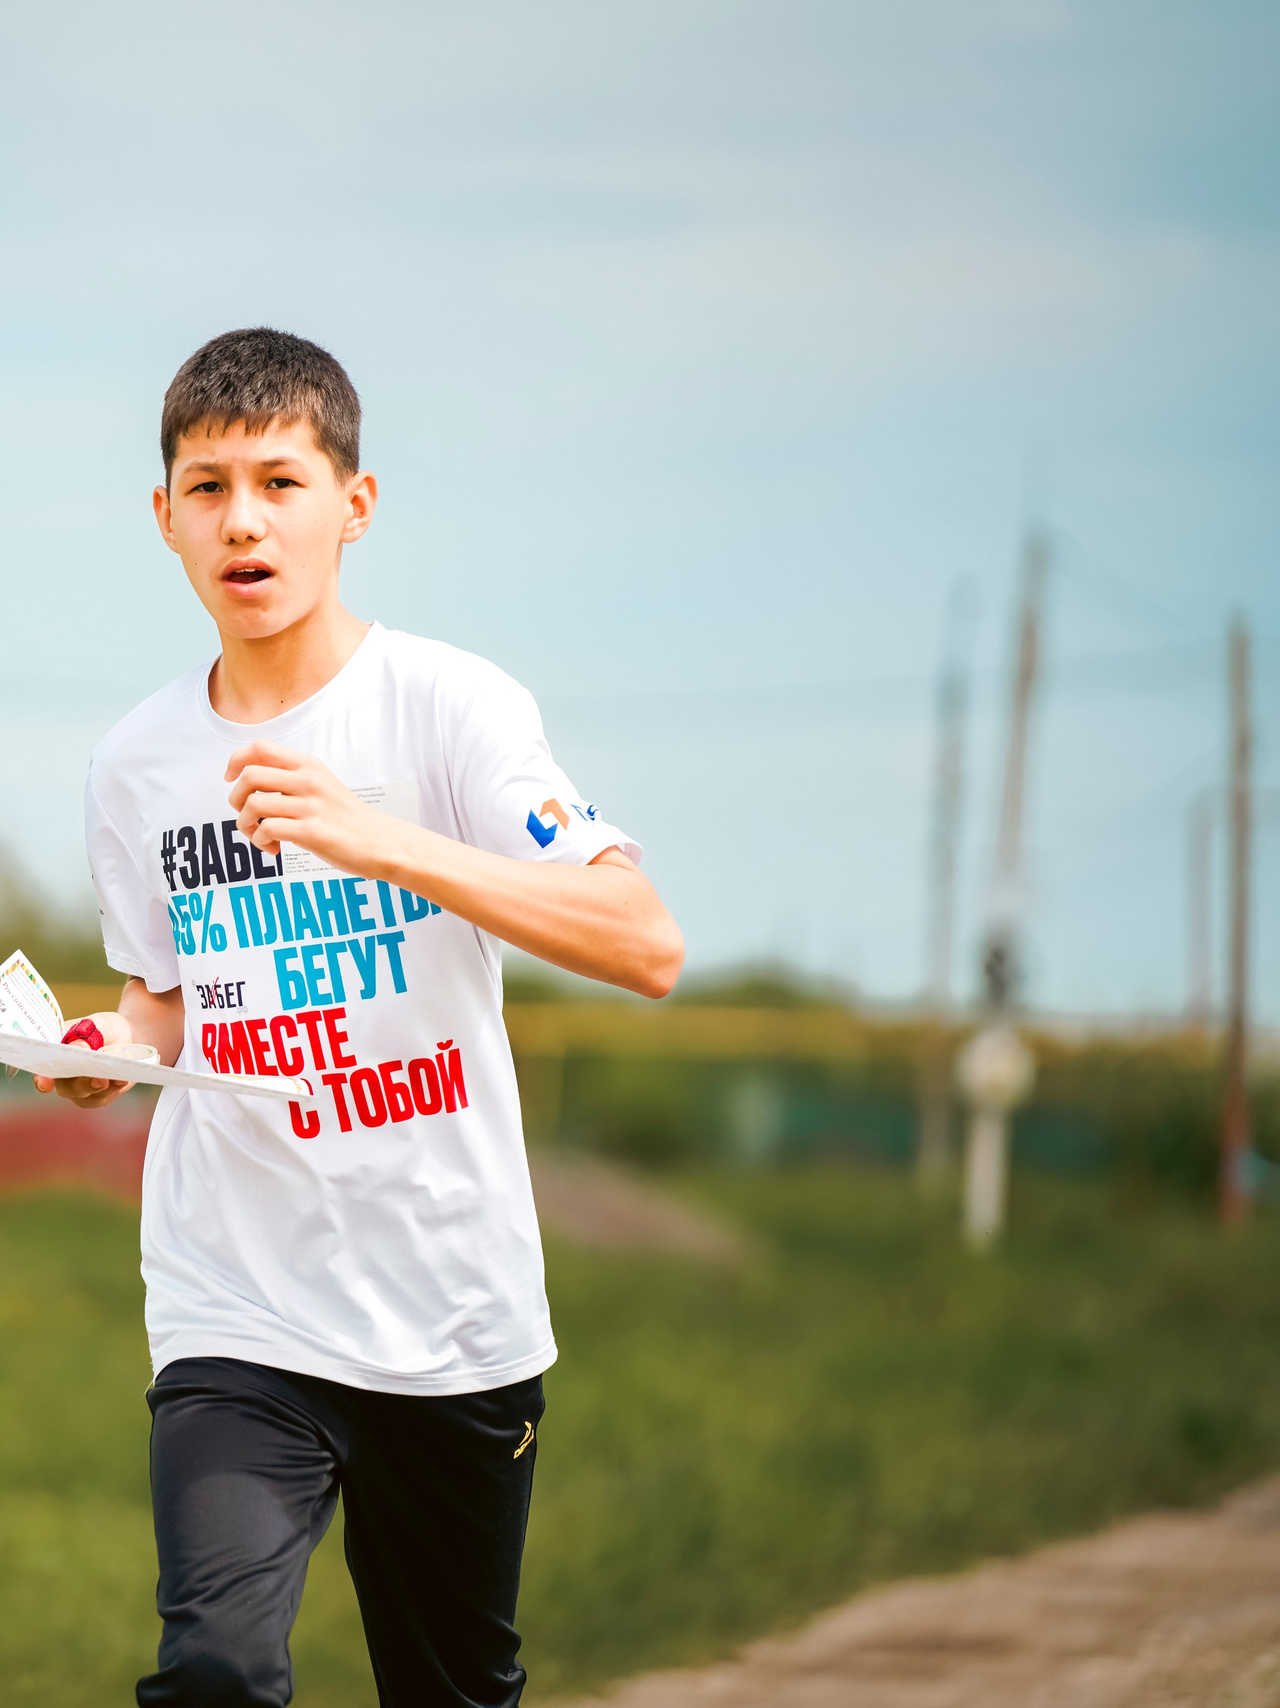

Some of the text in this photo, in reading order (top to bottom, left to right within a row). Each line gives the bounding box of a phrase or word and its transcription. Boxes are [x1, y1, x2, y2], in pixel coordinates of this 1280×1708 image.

[273, 930, 408, 1011] БЕГУТ
[202, 1007, 358, 1077] ВМЕСТЕ
[323, 1039, 469, 1134] ТОБОЙ
